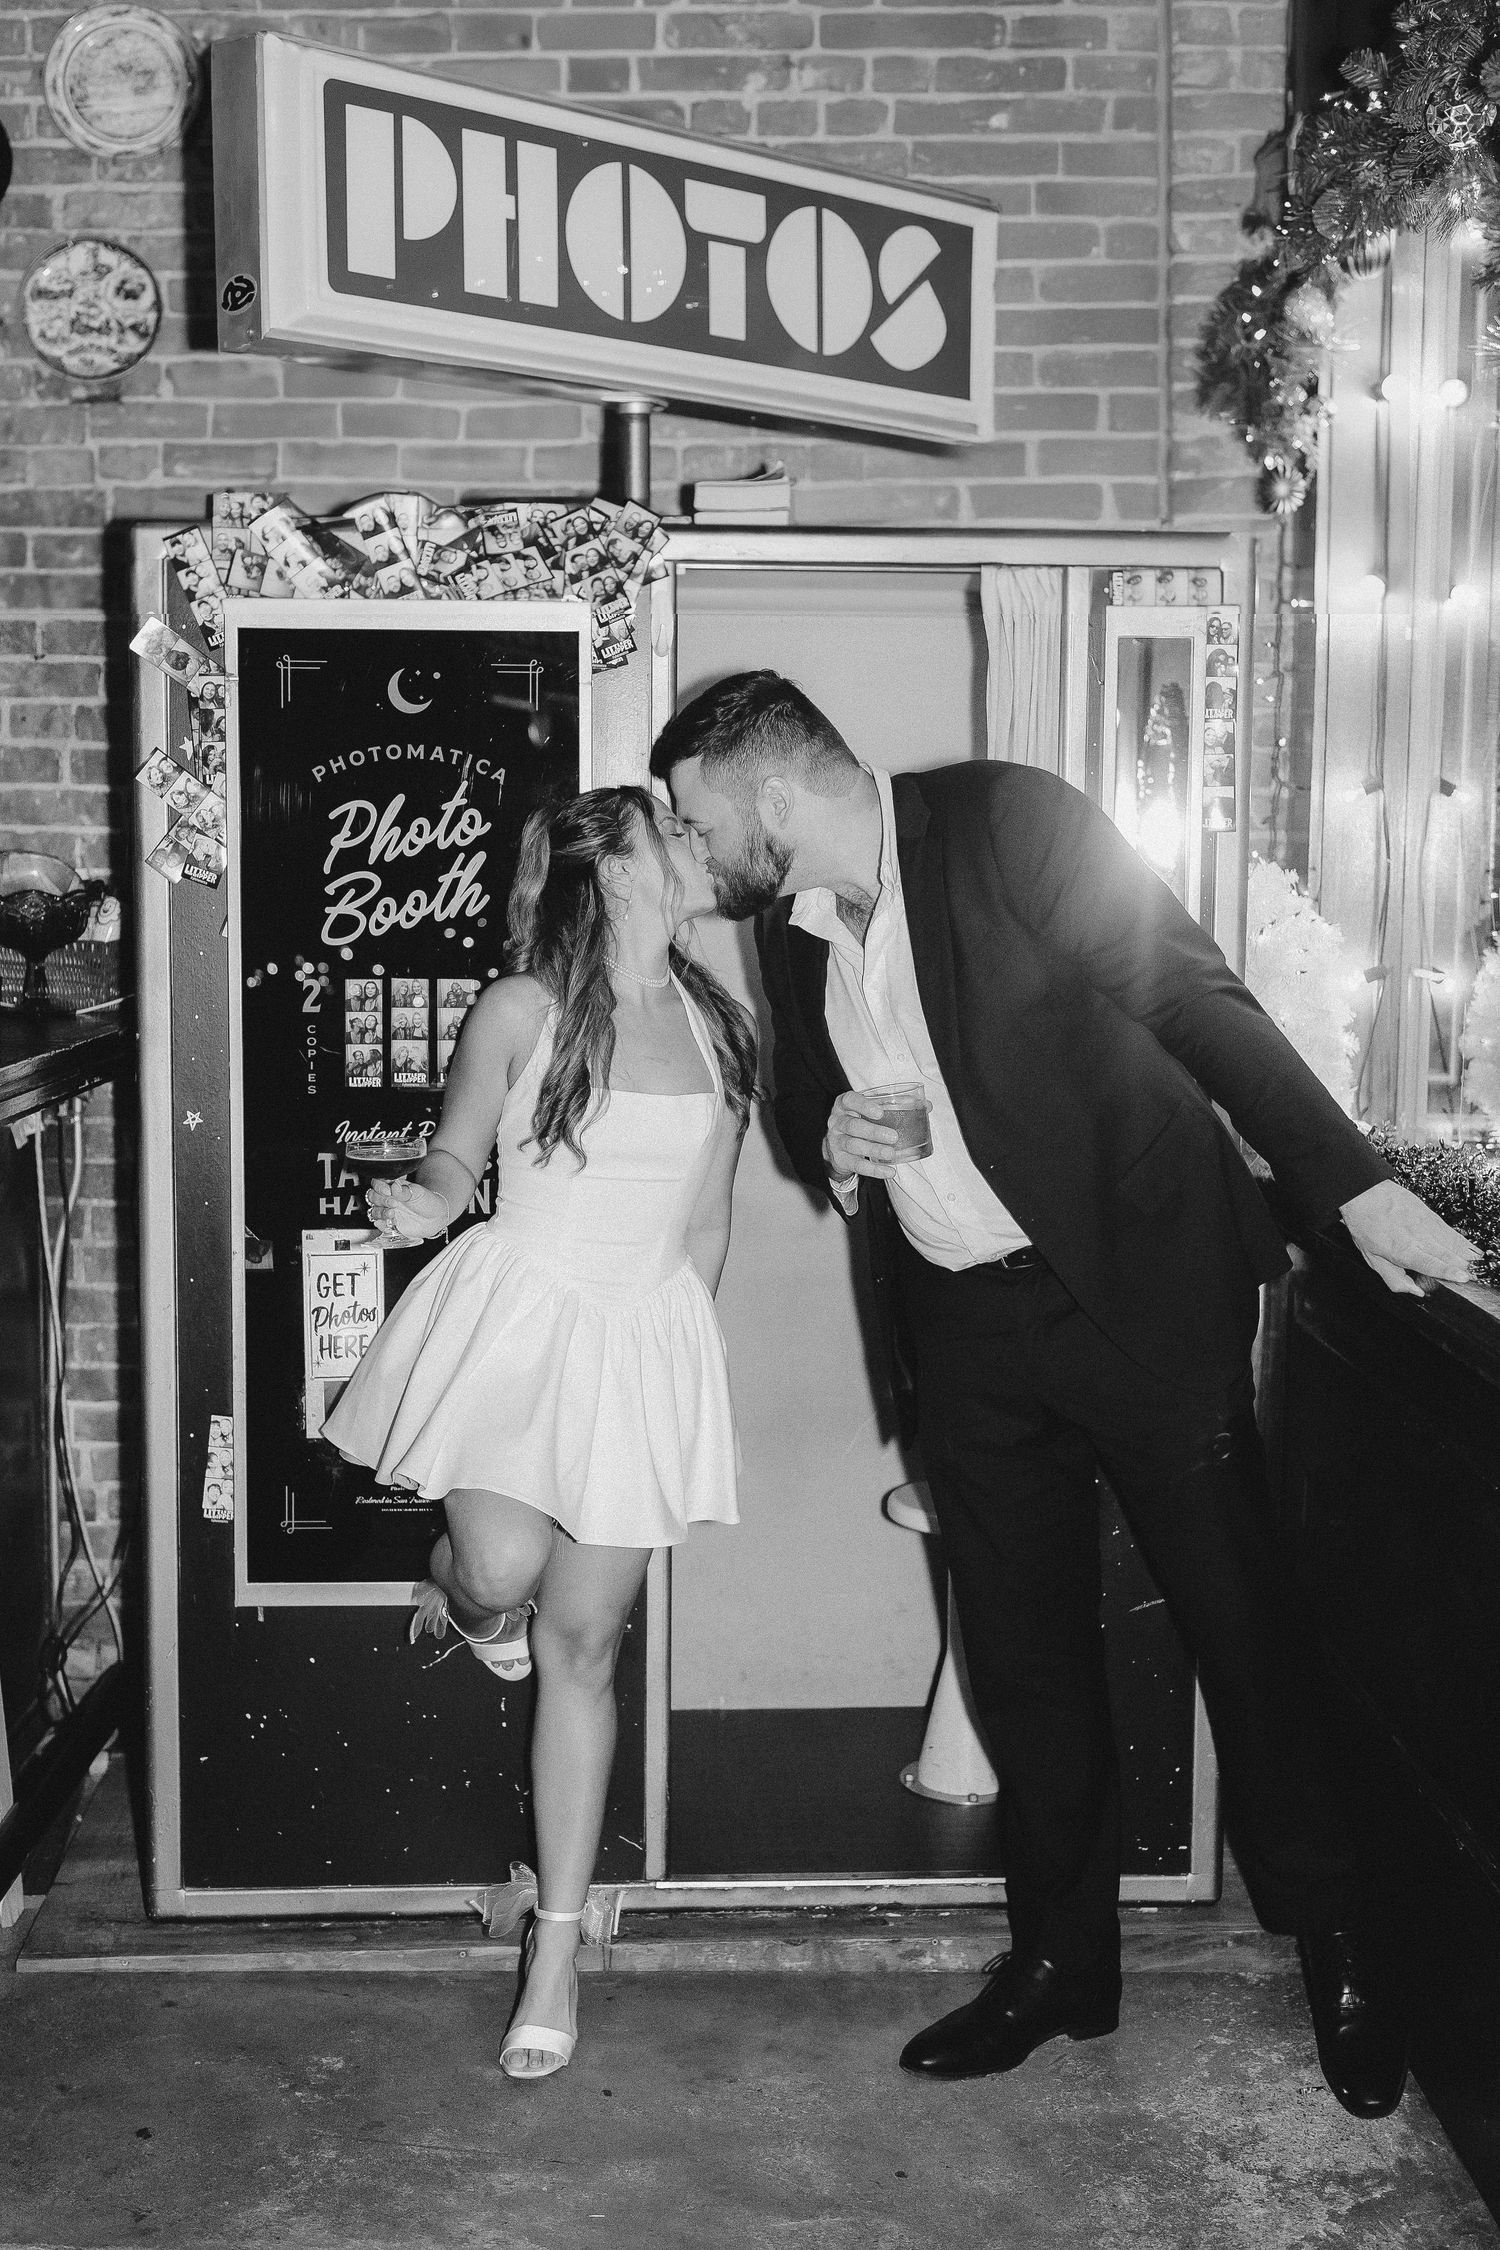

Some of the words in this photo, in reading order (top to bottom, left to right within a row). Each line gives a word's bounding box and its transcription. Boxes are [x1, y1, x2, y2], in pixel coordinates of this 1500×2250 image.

[345, 103, 948, 372] PHOTOS
[312, 744, 507, 786] PHOTOMATICA
[323, 780, 492, 875] Photo
[321, 851, 490, 946] Booth
[302, 979, 322, 1013] 2
[306, 1024, 317, 1094] COPIES
[316, 1272, 361, 1299] GET
[311, 1300, 378, 1336] Photos
[319, 1333, 370, 1361] HERE
